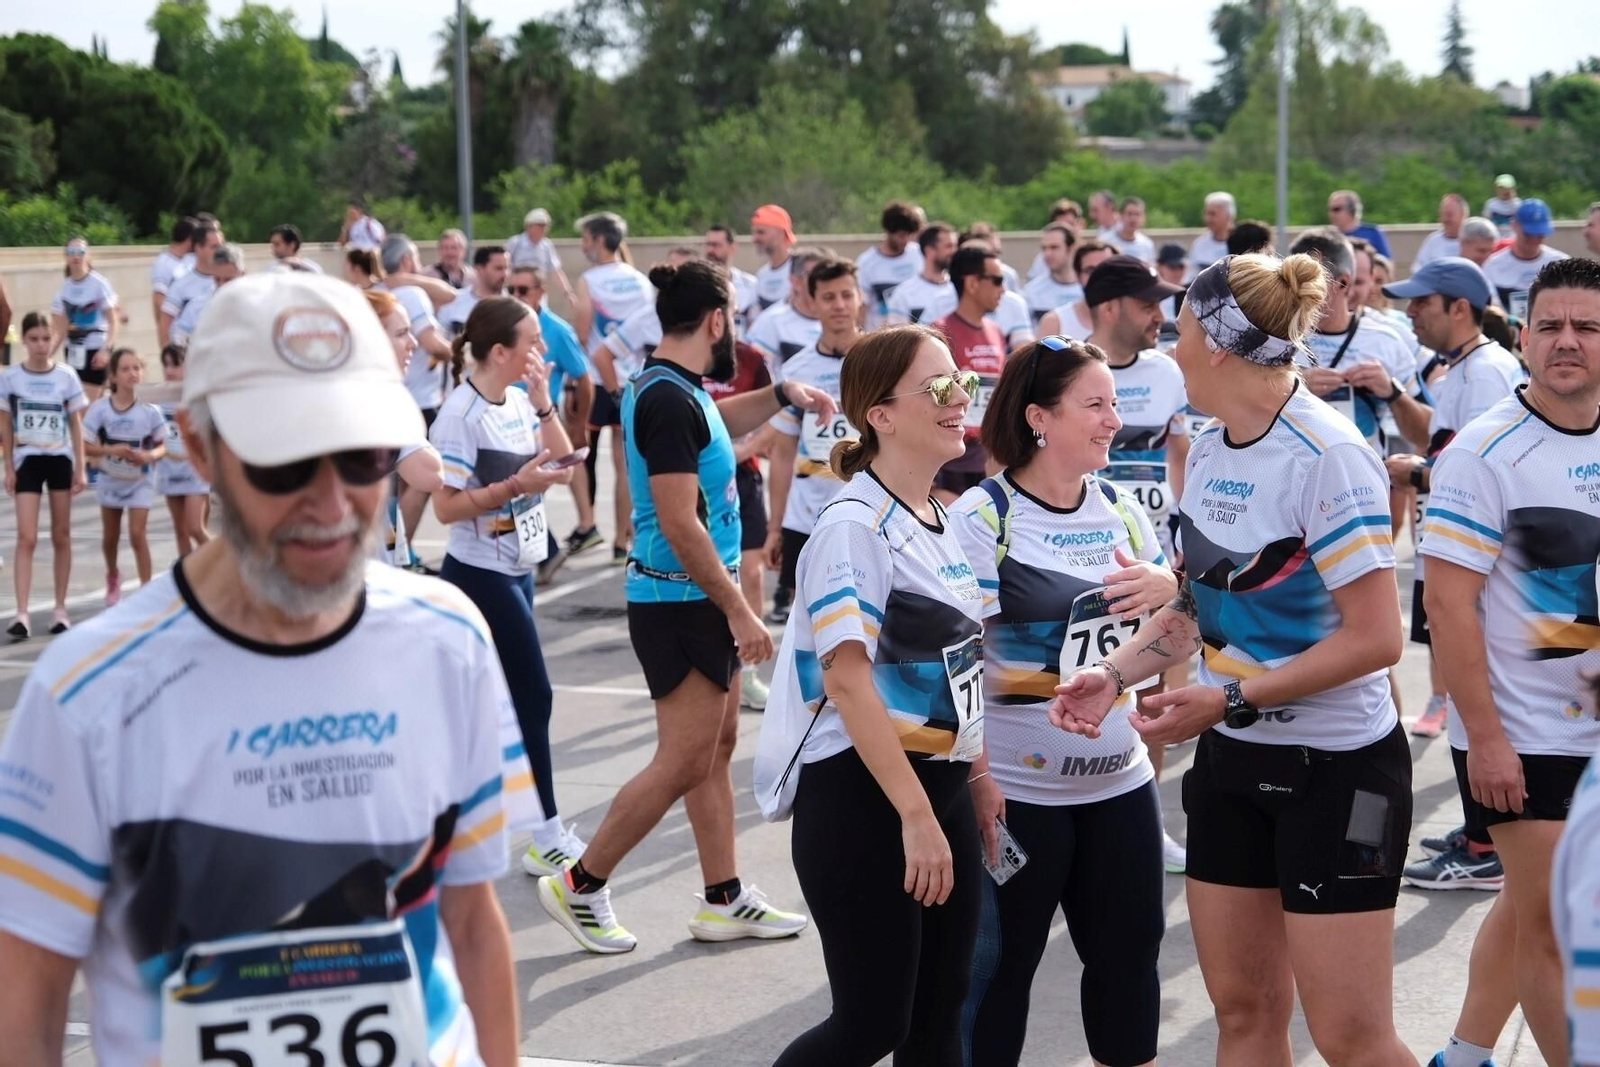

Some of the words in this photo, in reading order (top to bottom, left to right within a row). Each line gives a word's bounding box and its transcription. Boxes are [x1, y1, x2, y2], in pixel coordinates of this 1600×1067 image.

[23, 413, 60, 430] 878
[816, 420, 847, 438] 26
[1333, 486, 1374, 505] NOVRTIS
[520, 511, 544, 542] 330
[1052, 530, 1114, 548] CARRERA
[1081, 554, 1110, 567] SALUD
[1071, 617, 1140, 667] 767
[959, 667, 984, 720] 77
[226, 729, 240, 755] I
[246, 711, 397, 760] CARRERA
[233, 767, 264, 787] POR
[269, 766, 288, 782] LA
[290, 752, 396, 777] INVESTIGACIÓN
[1060, 746, 1135, 777] IMIBIC
[267, 783, 295, 808] EN
[301, 773, 372, 803] SALUD
[198, 1004, 397, 1067] 536
